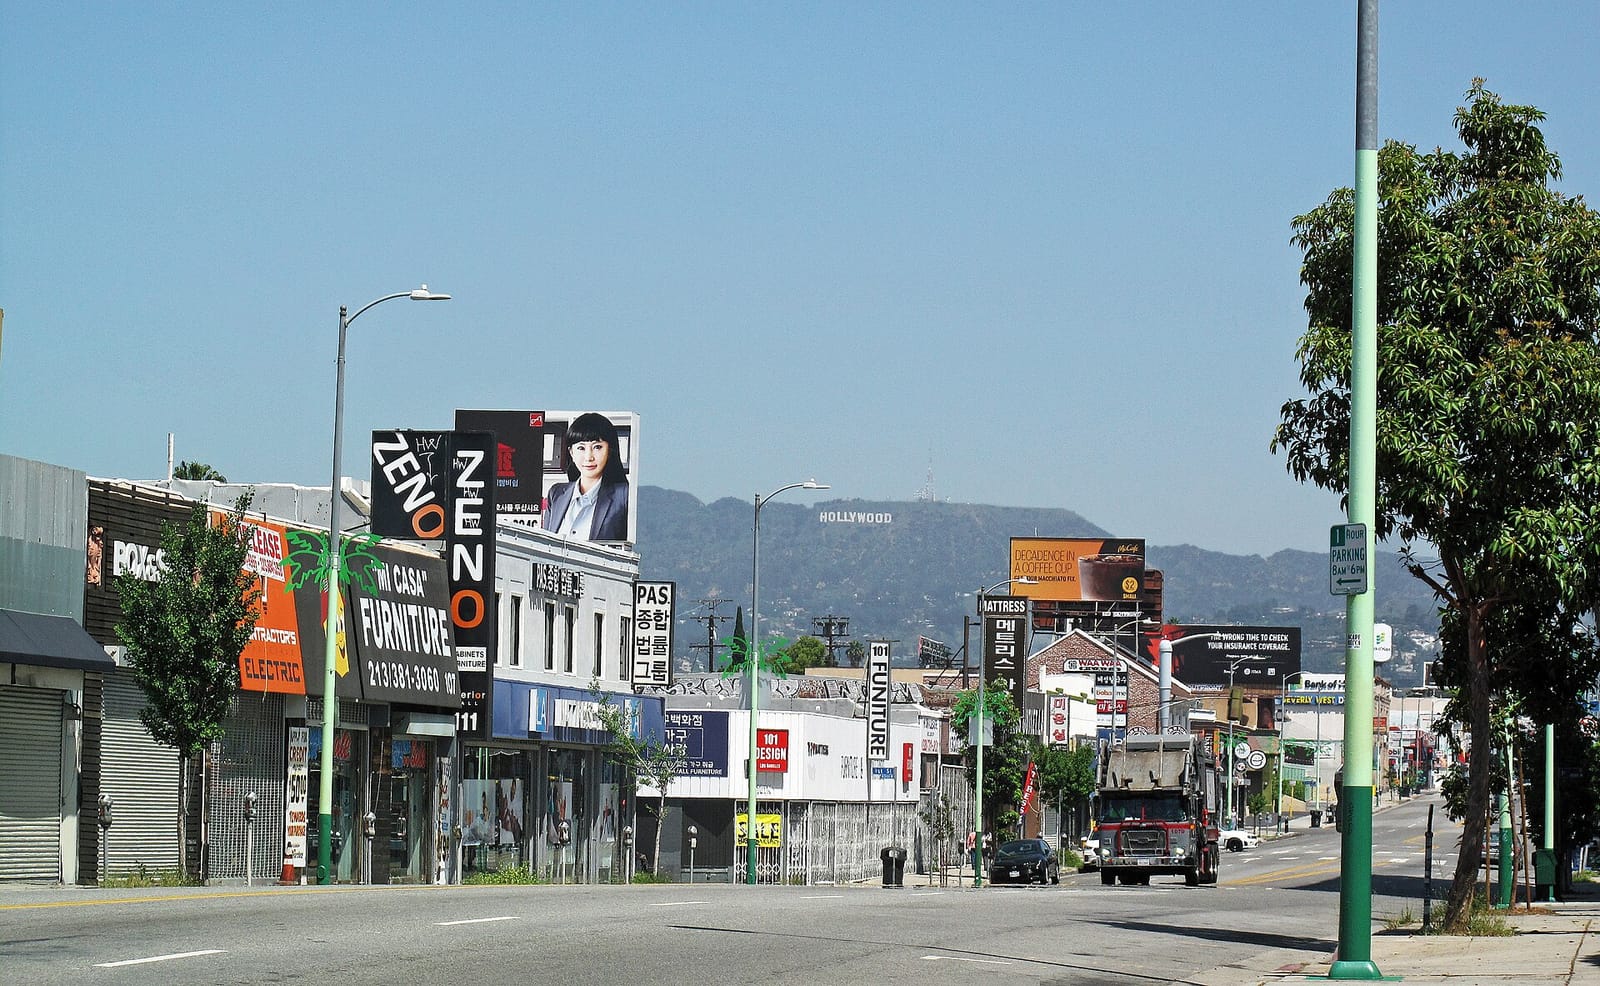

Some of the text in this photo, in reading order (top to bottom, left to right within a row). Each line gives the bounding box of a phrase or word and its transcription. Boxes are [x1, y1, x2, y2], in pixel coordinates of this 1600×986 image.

[373, 432, 445, 538] ZENO
[820, 511, 892, 523] HOLLYWOOD
[450, 450, 485, 629] ZENO
[1336, 528, 1365, 544] 1 HOUR
[252, 529, 282, 560] LEASE
[1015, 549, 1076, 561] DECADENCE IN
[1332, 548, 1365, 562] PARKING
[1015, 561, 1072, 573] A COFFEE CUP
[393, 564, 427, 598] CASA"
[1125, 579, 1136, 591] $2
[980, 600, 1025, 612] MATTRESS
[360, 597, 452, 657] FURNITURE
[637, 609, 669, 631] 종합
[994, 619, 1017, 670] 메트리스
[1222, 633, 1245, 641] WRONG
[1246, 633, 1260, 641] TIME
[1269, 634, 1289, 642] CHECK
[636, 635, 668, 656] 법률
[872, 645, 888, 657] 101
[1224, 642, 1257, 650] INSURANCE
[456, 650, 485, 658] ABINETS
[245, 657, 301, 683] ELECTRIC
[457, 660, 486, 668] RNITURE
[635, 660, 667, 681] 그룹
[368, 660, 440, 693] 213/381-3060
[1304, 680, 1337, 690] Bank of
[460, 691, 486, 700] erior
[1286, 696, 1313, 705] EVERLY
[1315, 696, 1335, 705] WEST
[870, 661, 887, 756] FUNITURE
[764, 733, 778, 746] 101
[756, 747, 787, 761] DESIGN
[738, 821, 780, 839] SLE
